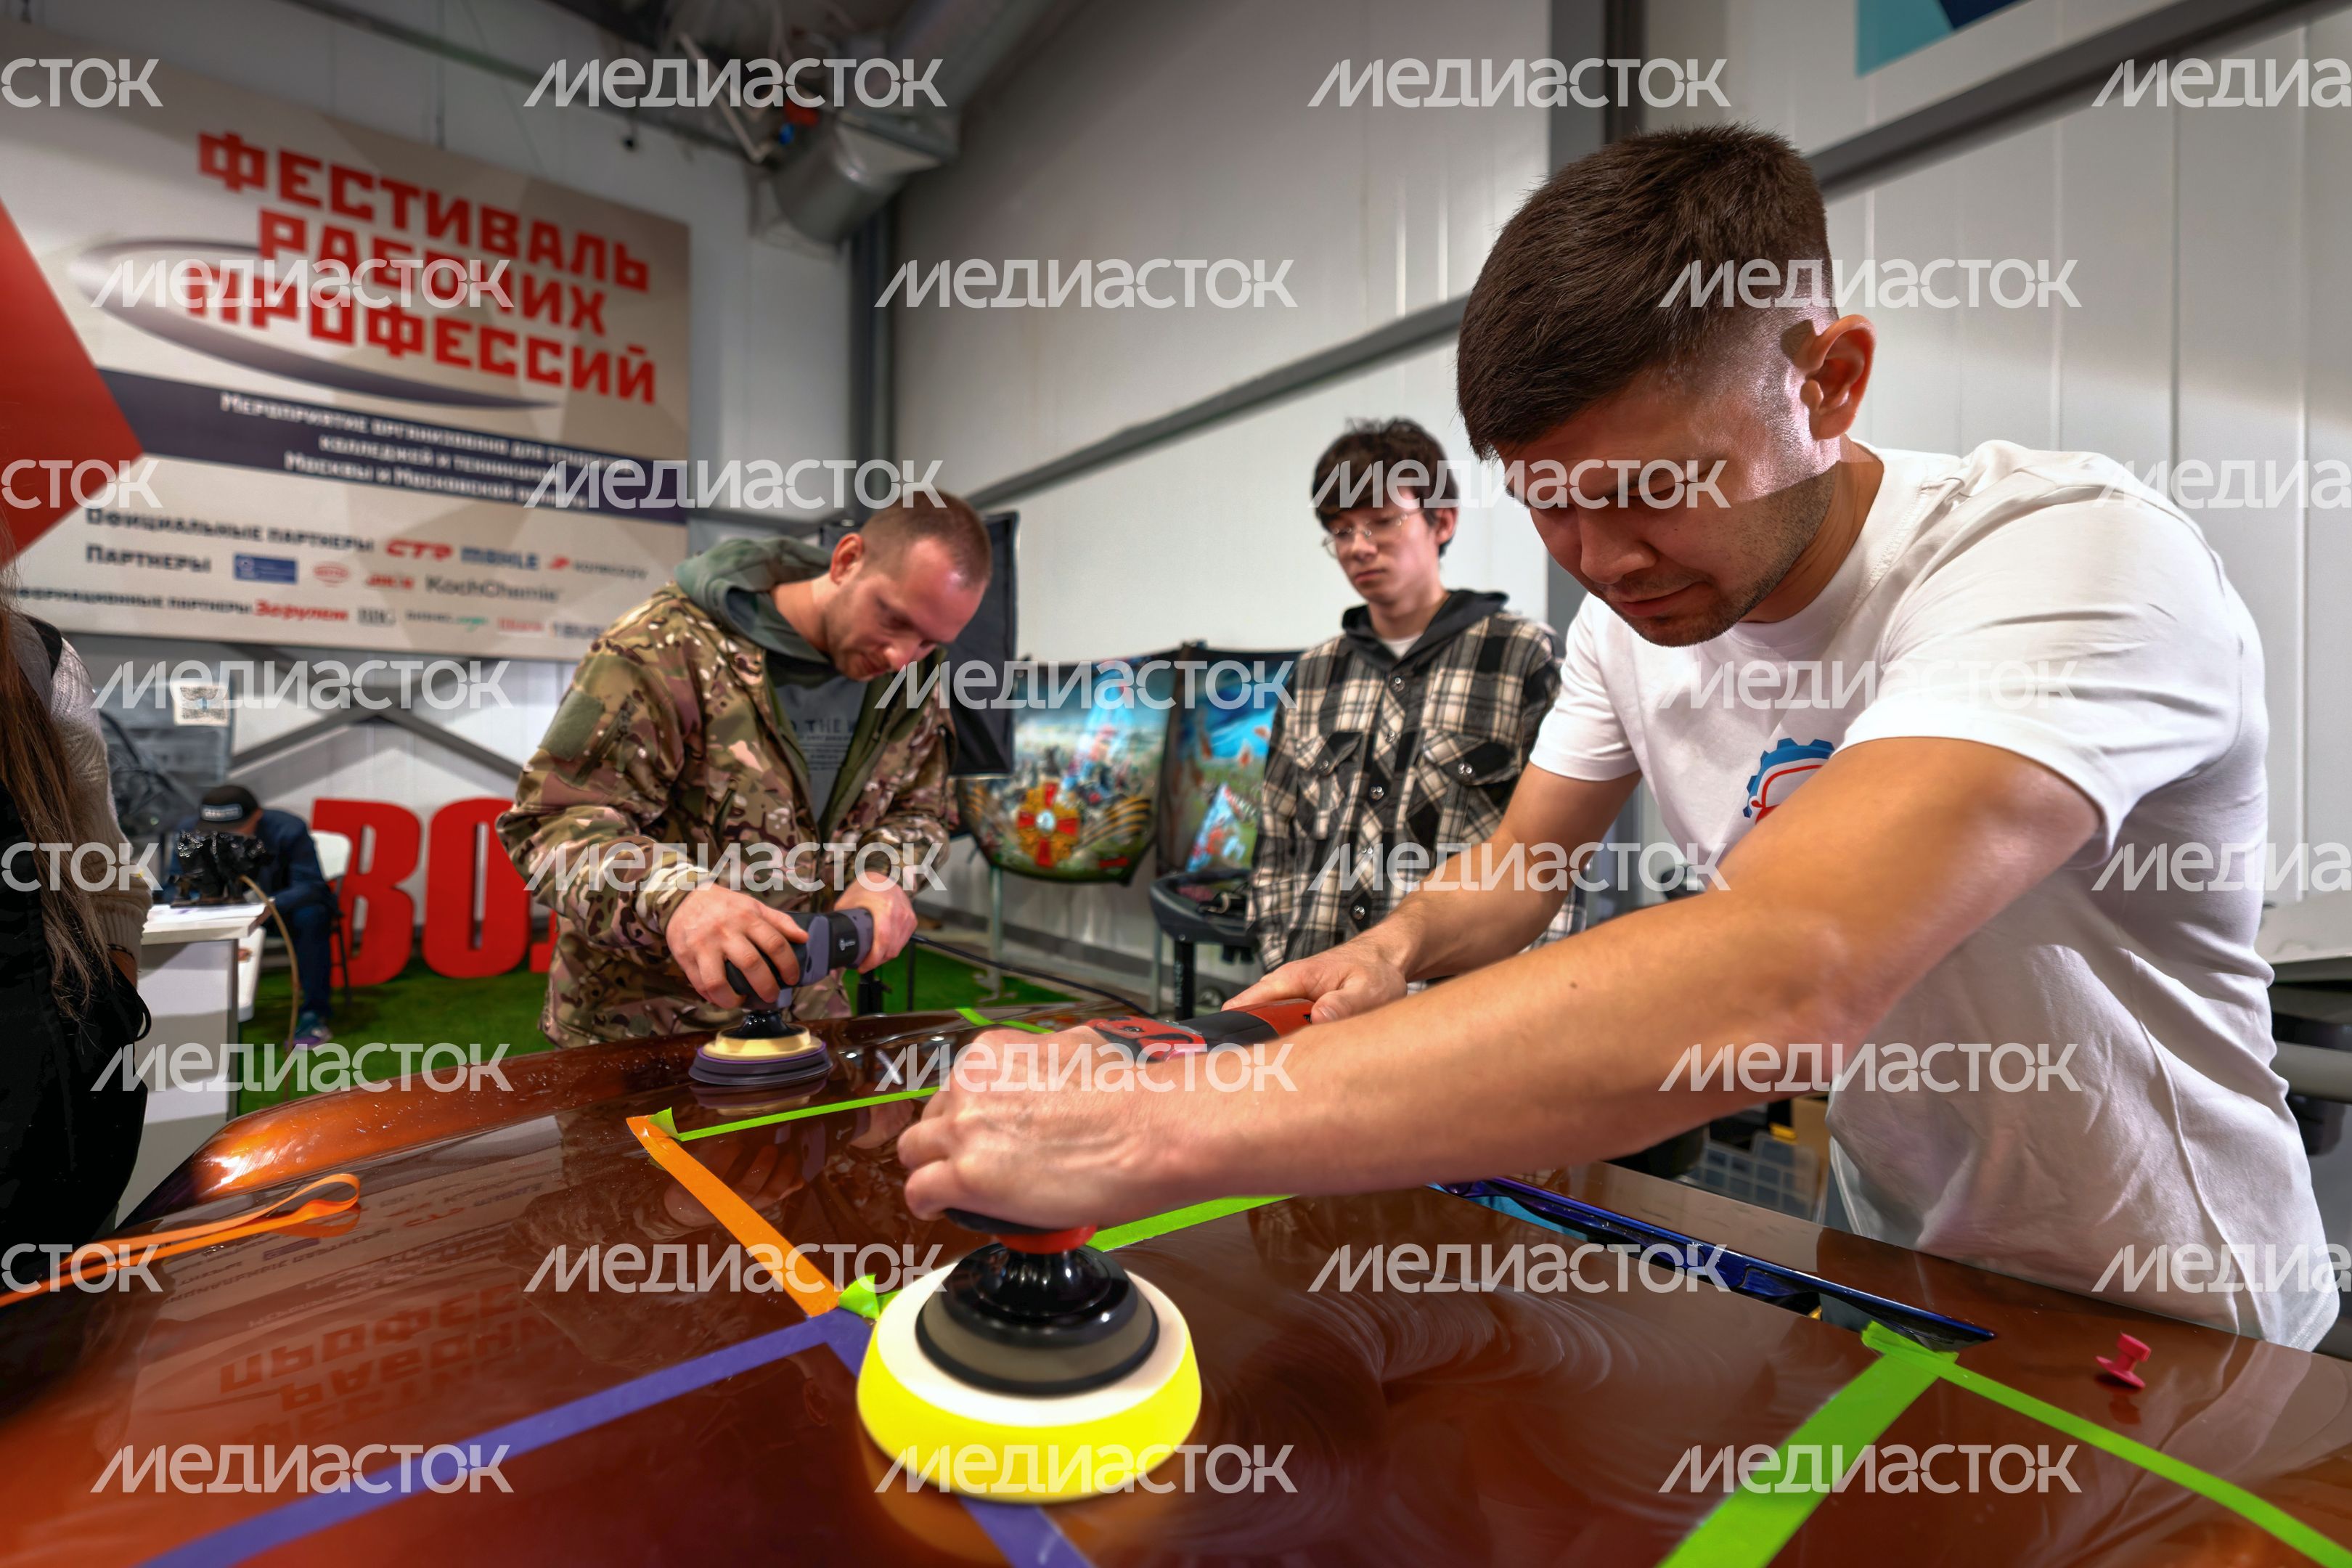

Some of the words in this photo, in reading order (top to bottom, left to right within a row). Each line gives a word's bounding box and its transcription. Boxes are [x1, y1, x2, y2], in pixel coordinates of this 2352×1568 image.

[197, 131, 648, 293] ФЕСТИВАЛЬ
[259, 208, 607, 337] РАБОЧИХ
[184, 261, 656, 406] ПРОФЕССИЙ
